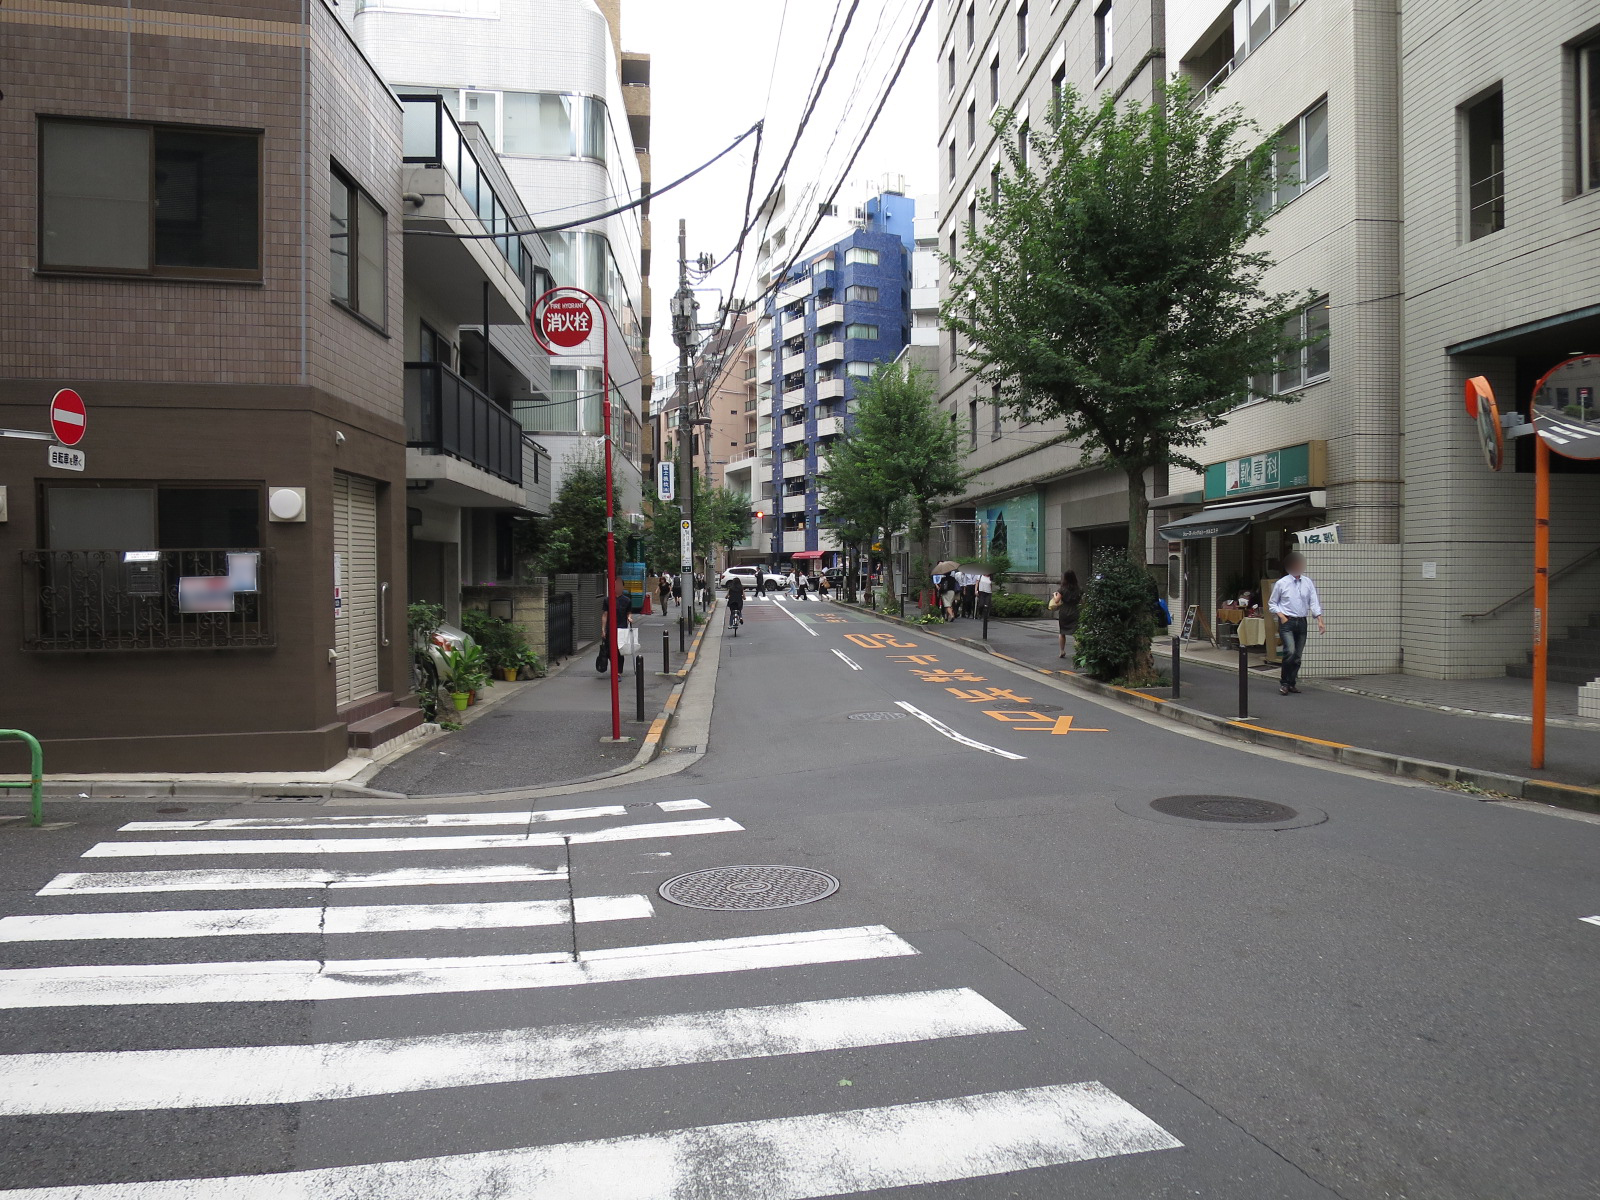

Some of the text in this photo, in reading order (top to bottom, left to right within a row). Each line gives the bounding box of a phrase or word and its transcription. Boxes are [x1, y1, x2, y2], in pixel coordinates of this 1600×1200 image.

[546, 312, 590, 332] 消火栓
[52, 452, 82, 467] 自転車を除く
[1240, 456, 1278, 484] 靴専科
[843, 633, 918, 649] 30
[885, 654, 1109, 735] 右折禁止
